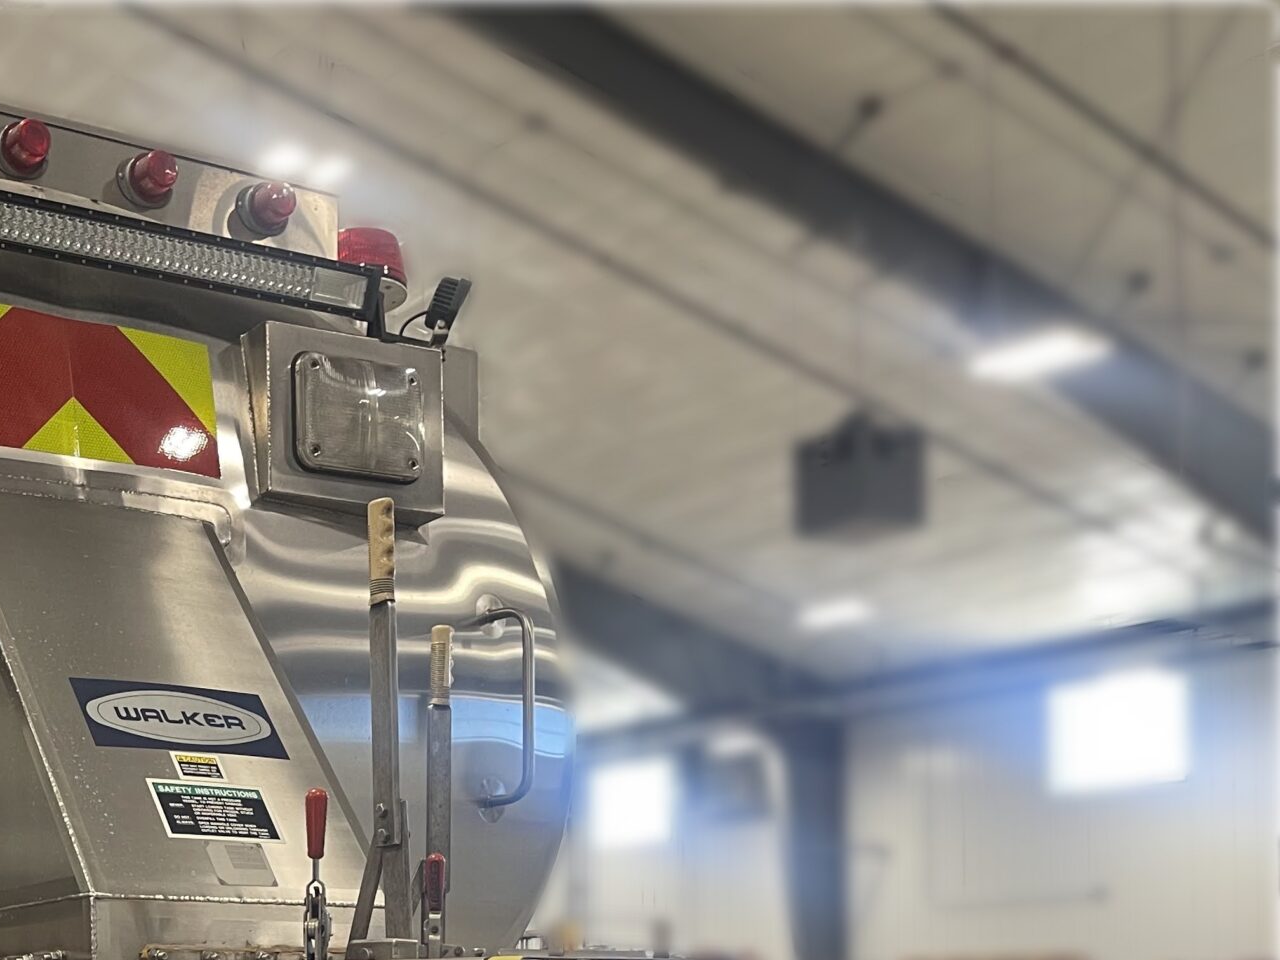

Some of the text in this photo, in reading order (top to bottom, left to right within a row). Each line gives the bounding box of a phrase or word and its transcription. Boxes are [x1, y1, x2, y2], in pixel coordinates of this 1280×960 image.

[113, 706, 246, 730] WALKER
[158, 785, 257, 798] SAFETY INSTRUCTIONS
